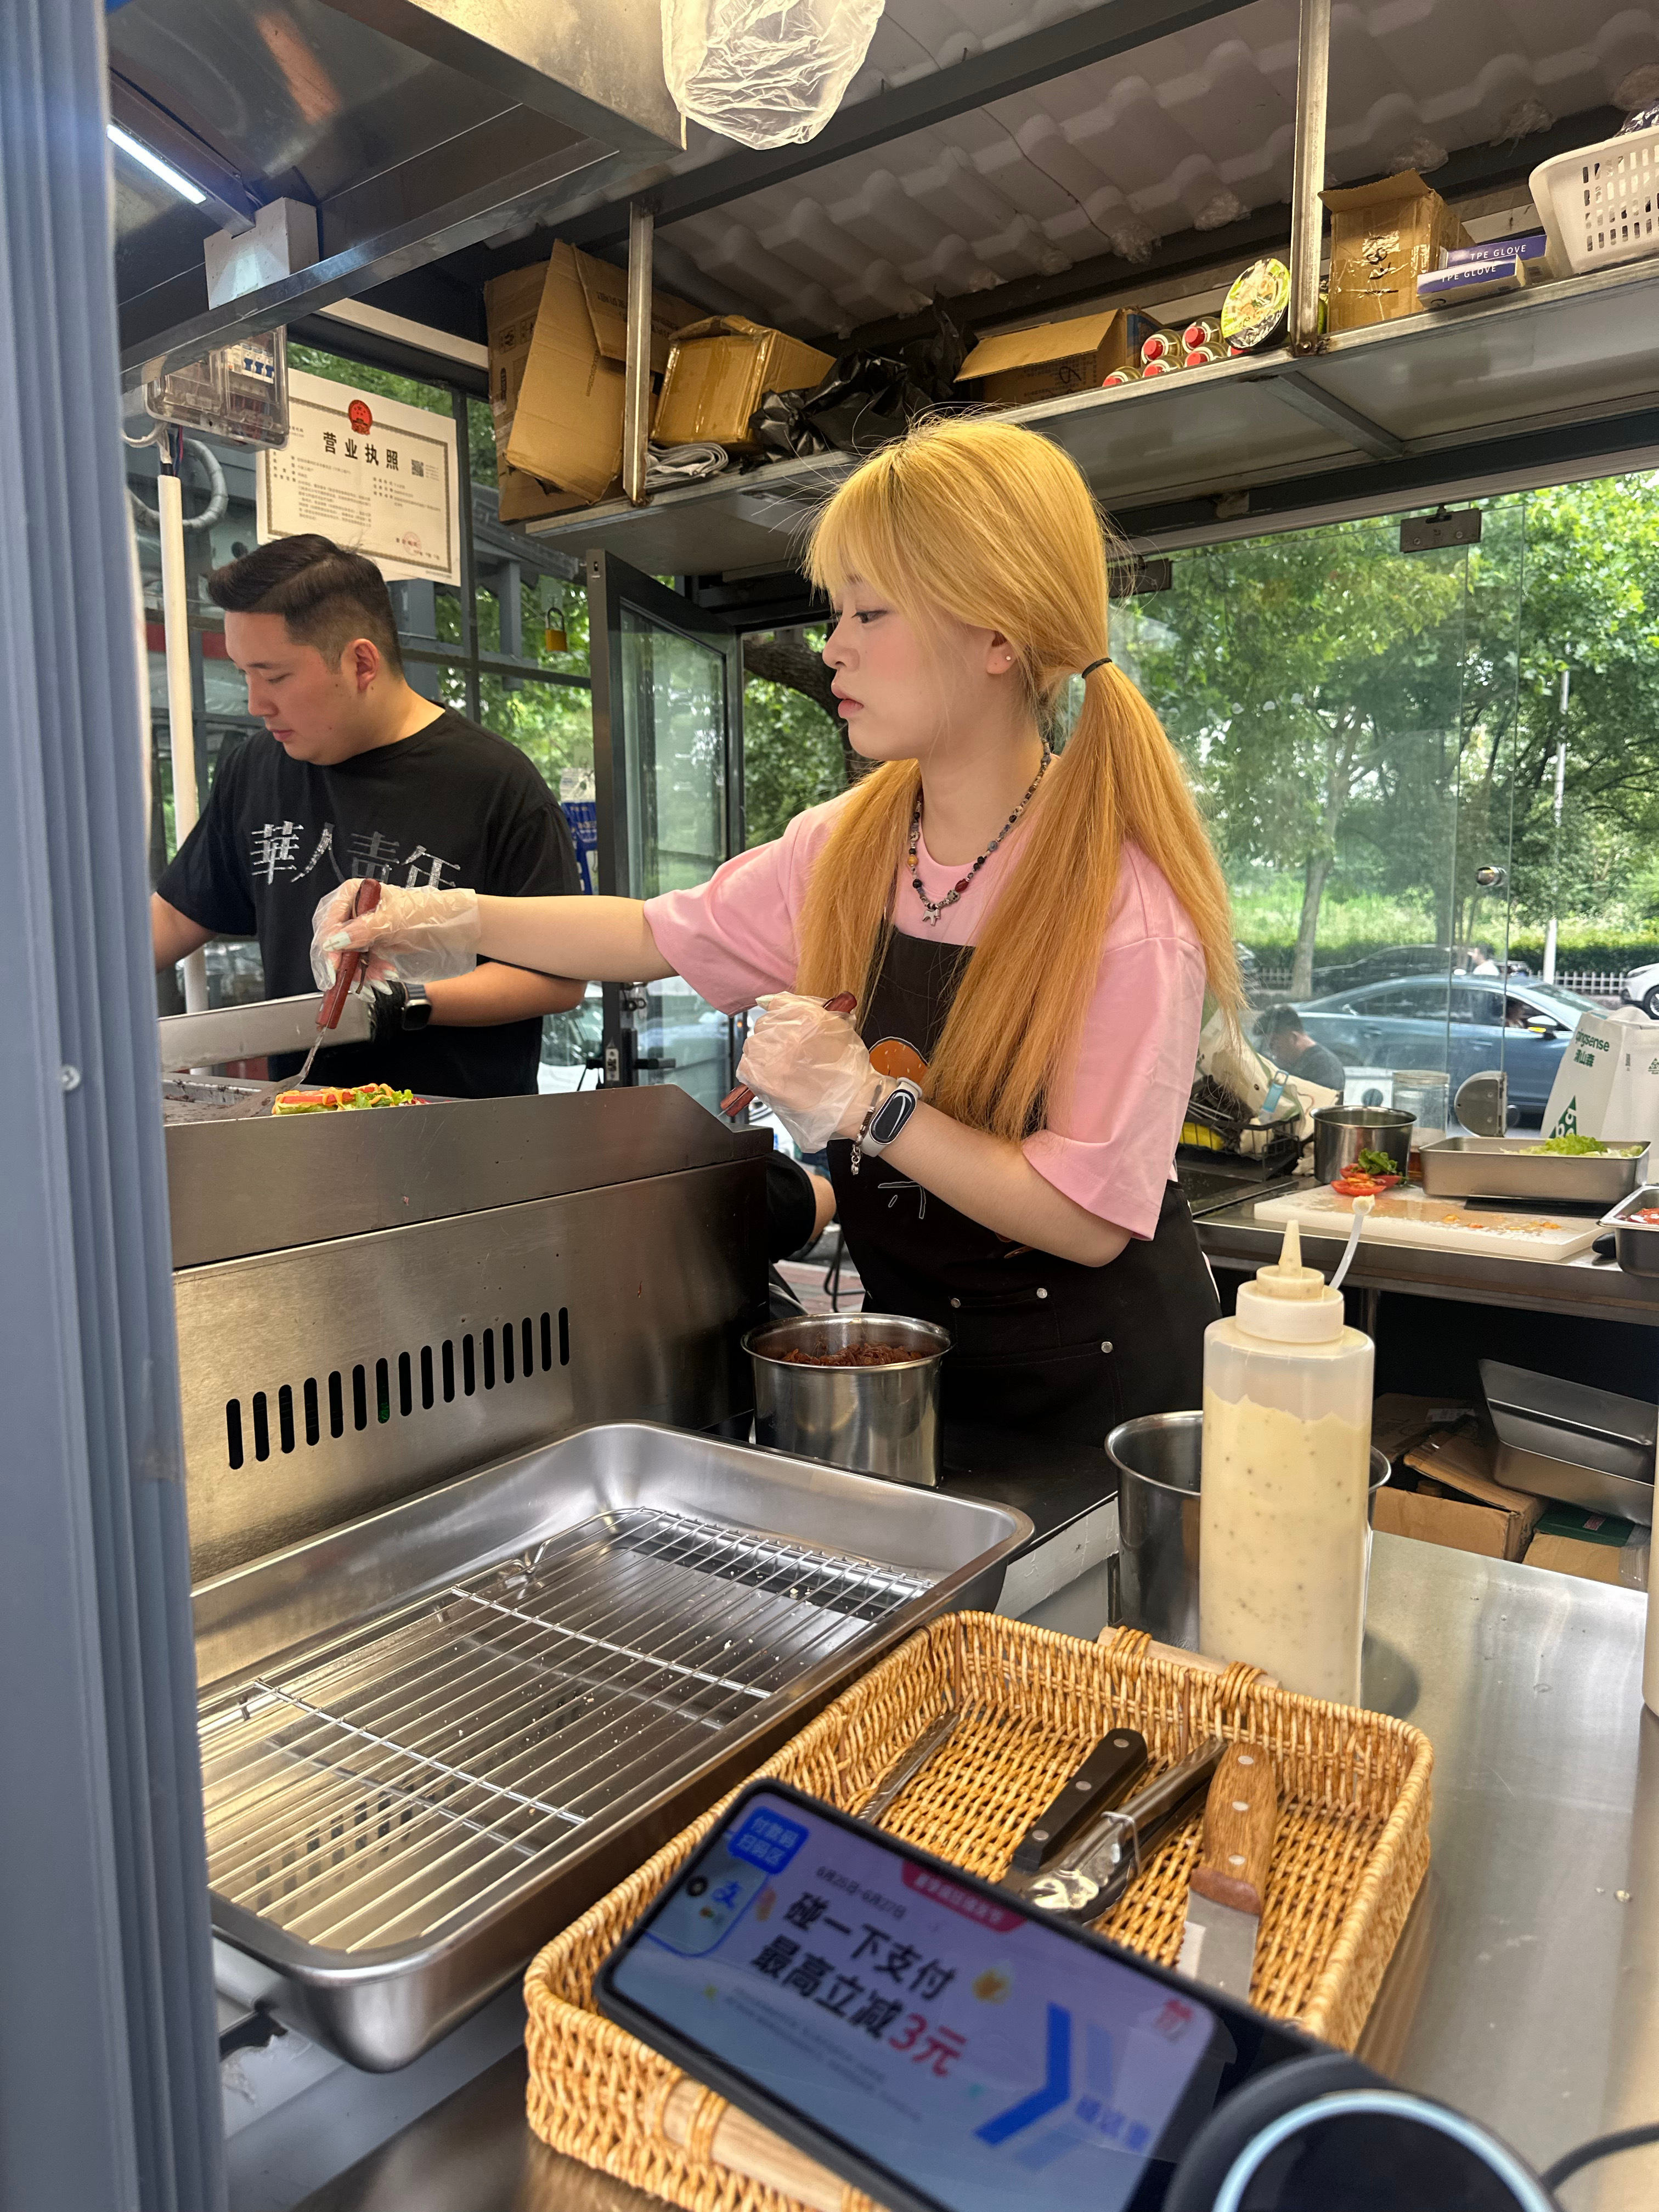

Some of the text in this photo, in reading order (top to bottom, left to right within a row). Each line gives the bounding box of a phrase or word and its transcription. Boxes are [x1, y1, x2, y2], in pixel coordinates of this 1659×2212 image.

[1470, 244, 1527, 261] TPE GLOVE
[1442, 265, 1497, 283] TPE GLOVE
[323, 431, 399, 471] 营业执照
[782, 1891, 956, 2001] 碰一下支付
[749, 1934, 968, 2077] 最高立减3元
